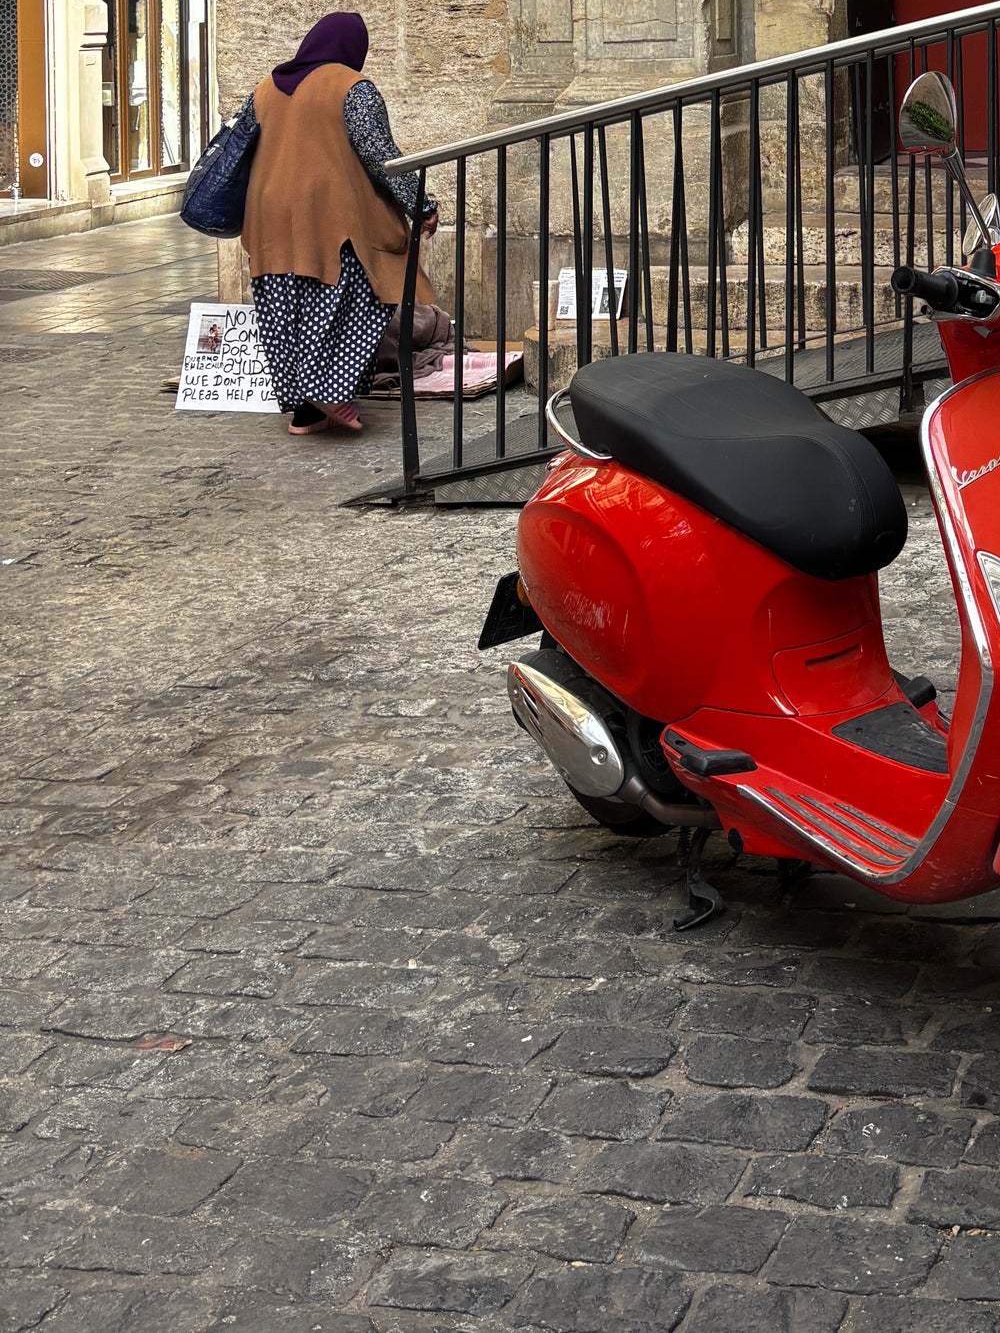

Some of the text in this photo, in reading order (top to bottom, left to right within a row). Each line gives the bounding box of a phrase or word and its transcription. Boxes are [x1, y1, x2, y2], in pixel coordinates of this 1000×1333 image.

[225, 309, 247, 328] NO
[221, 343, 251, 362] POR
[185, 374, 209, 387] WE
[213, 374, 245, 386] DONT
[226, 388, 253, 402] HELP
